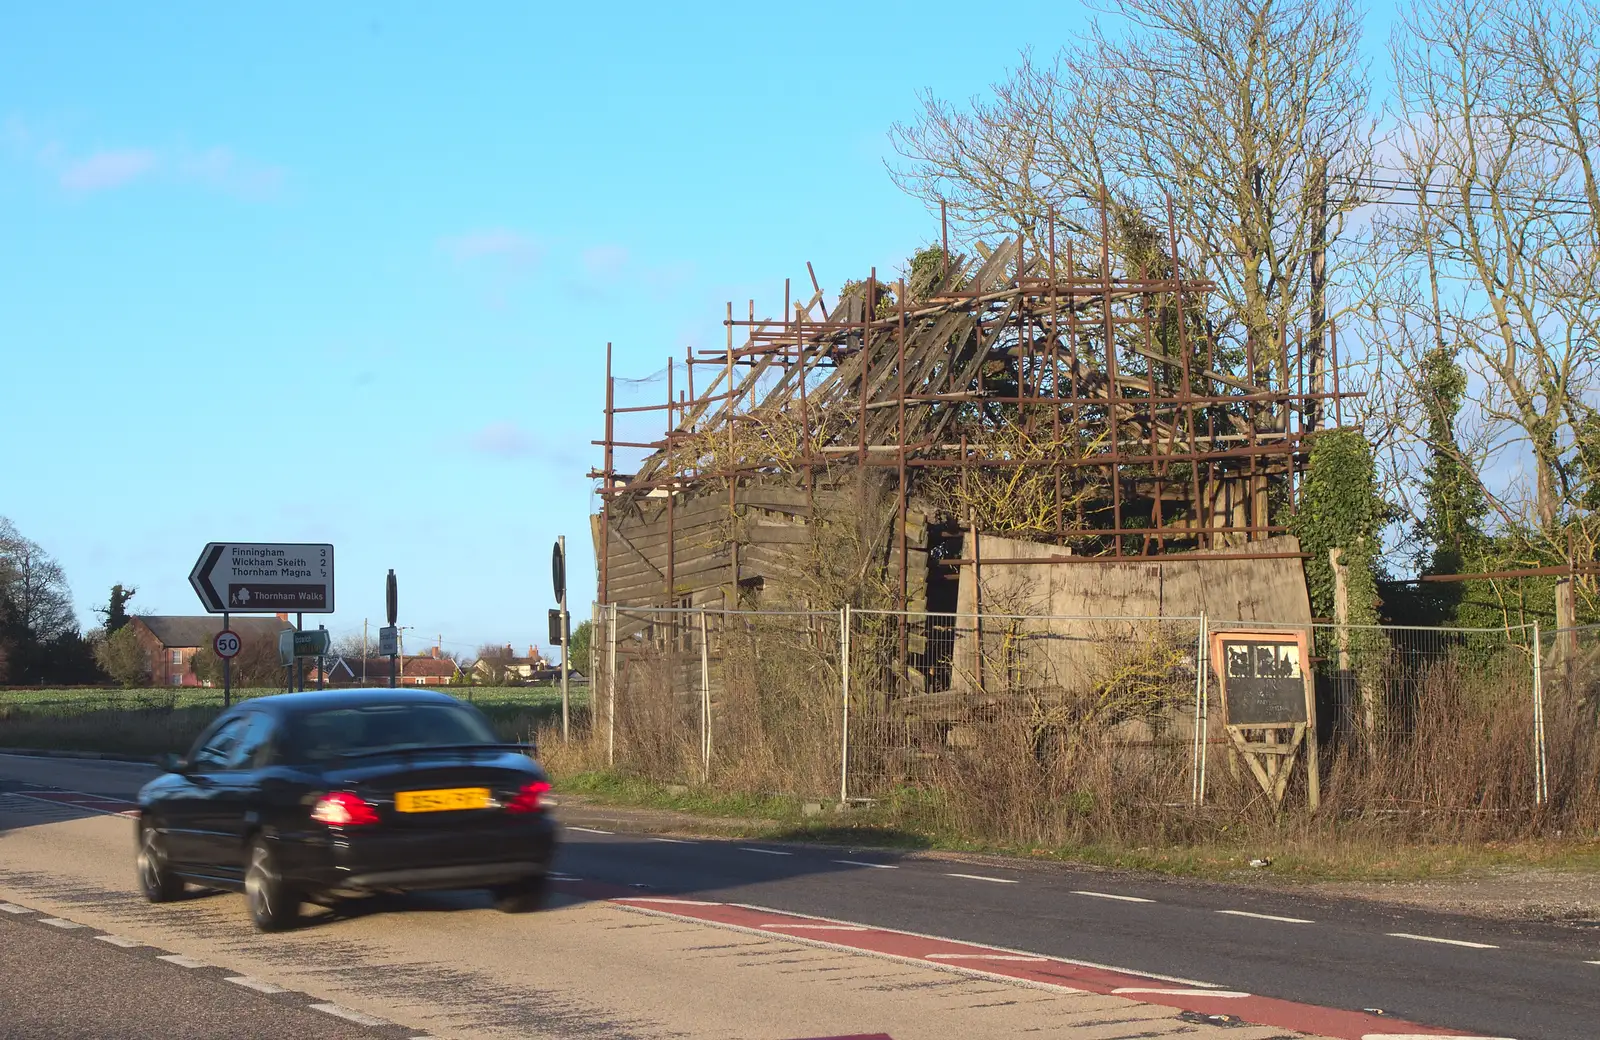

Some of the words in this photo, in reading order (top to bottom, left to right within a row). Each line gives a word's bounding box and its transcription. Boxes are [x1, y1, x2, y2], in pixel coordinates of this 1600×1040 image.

[232, 547, 284, 557] Finningham
[320, 549, 326, 557] 3
[232, 558, 273, 567] Wickham
[277, 558, 306, 567] Skeith
[320, 559, 326, 567] 2
[232, 568, 277, 576] Thornham
[281, 568, 311, 578] Magna
[254, 592, 296, 600] Thornham
[298, 592, 323, 600] Walks
[219, 639, 238, 651] 50
